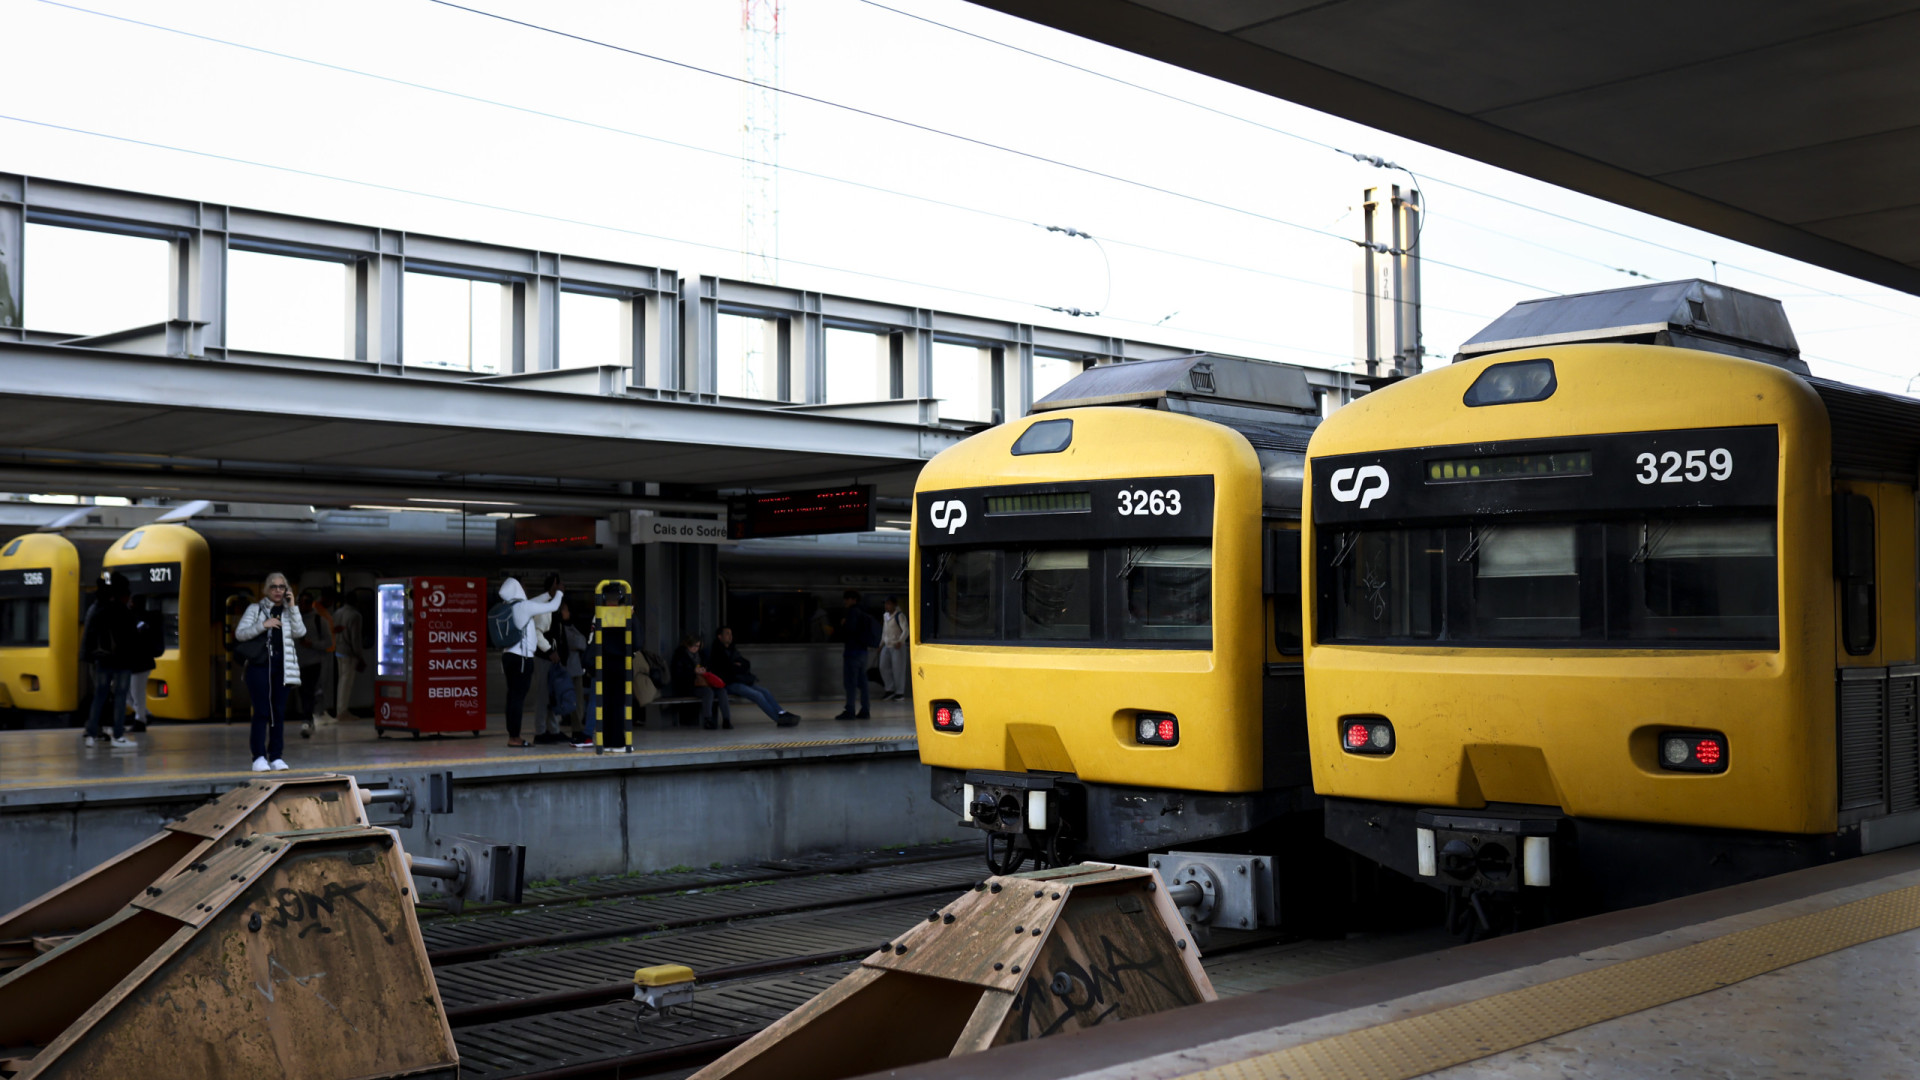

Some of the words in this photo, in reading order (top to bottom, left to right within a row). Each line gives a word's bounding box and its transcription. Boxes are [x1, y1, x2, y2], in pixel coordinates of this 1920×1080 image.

[1636, 447, 1733, 485] 3259
[1117, 489, 1182, 516] 3263
[653, 523, 679, 536] Cais
[681, 524, 694, 536] do
[697, 524, 727, 538] Sodré
[149, 567, 172, 583] 3271
[428, 620, 453, 630] COLD
[428, 630, 478, 644] DRINKS
[428, 659, 478, 670] SNACKS
[428, 686, 479, 699] BEBIDAS
[454, 700, 479, 709] FRIAS
